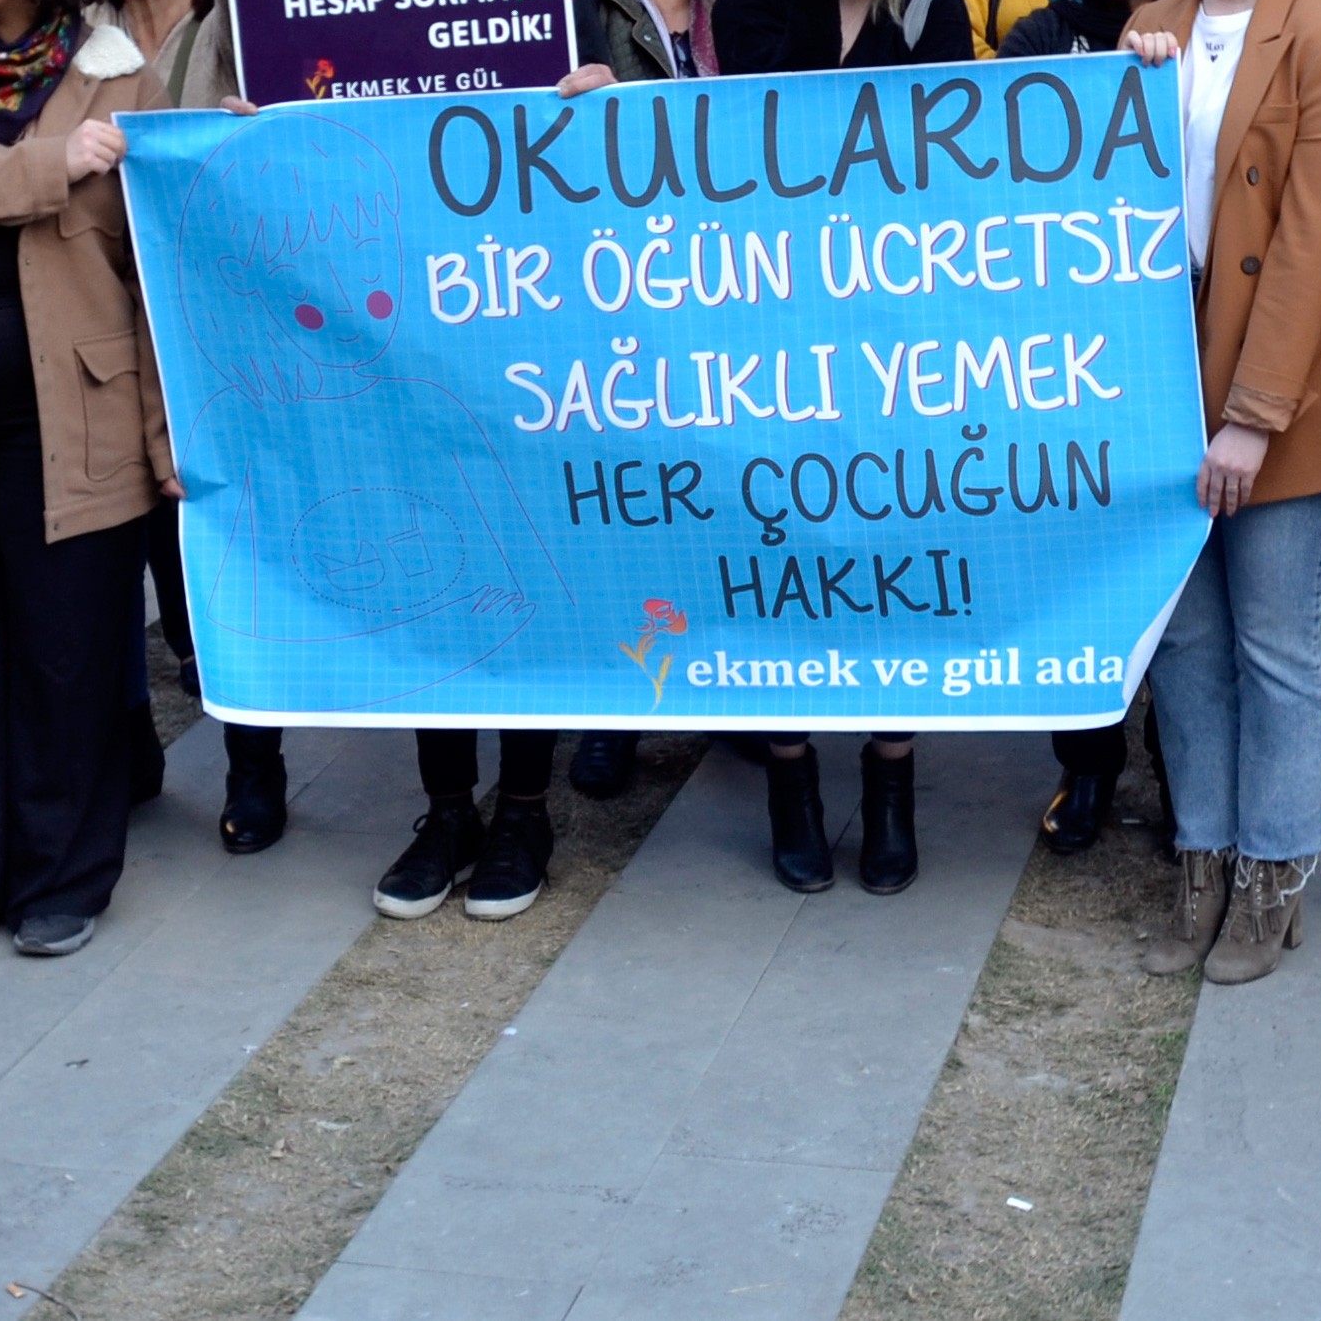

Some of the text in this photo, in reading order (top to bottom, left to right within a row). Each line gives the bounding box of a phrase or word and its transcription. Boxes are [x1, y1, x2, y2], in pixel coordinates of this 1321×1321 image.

[428, 10, 553, 49] GELDİK!
[331, 67, 503, 100] EKMEK VE GÜL
[428, 66, 1172, 217] OKULLARDA
[424, 195, 1184, 325] BİR ÖĞÜN ÜCRETSİZ
[505, 332, 1123, 433] SAĞLIKLI YEMEK
[563, 424, 1113, 545] HER ÇOCUĞUN
[718, 551, 973, 620] HAKKI!
[686, 649, 860, 687] ekmek
[872, 659, 929, 687] ve
[941, 647, 1021, 697] gül
